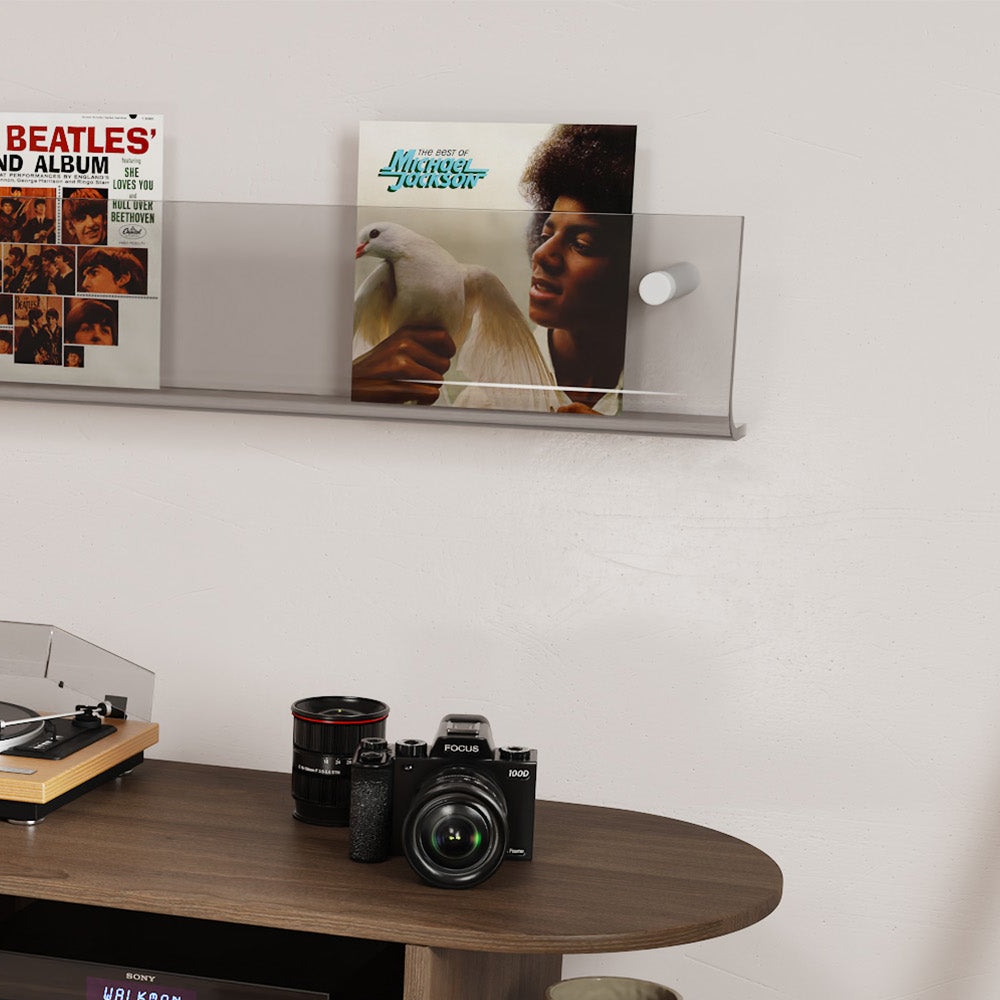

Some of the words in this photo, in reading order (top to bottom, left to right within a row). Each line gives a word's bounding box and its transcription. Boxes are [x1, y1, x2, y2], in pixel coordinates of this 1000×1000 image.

[458, 149, 470, 157] OF
[34, 155, 109, 174] ALBUM
[124, 167, 140, 178] SHE
[112, 179, 137, 190] LOVES
[138, 180, 154, 191] YOU
[110, 211, 155, 224] BEETHOVEN
[444, 744, 480, 753] FOCUS
[126, 973, 156, 983] SONY
